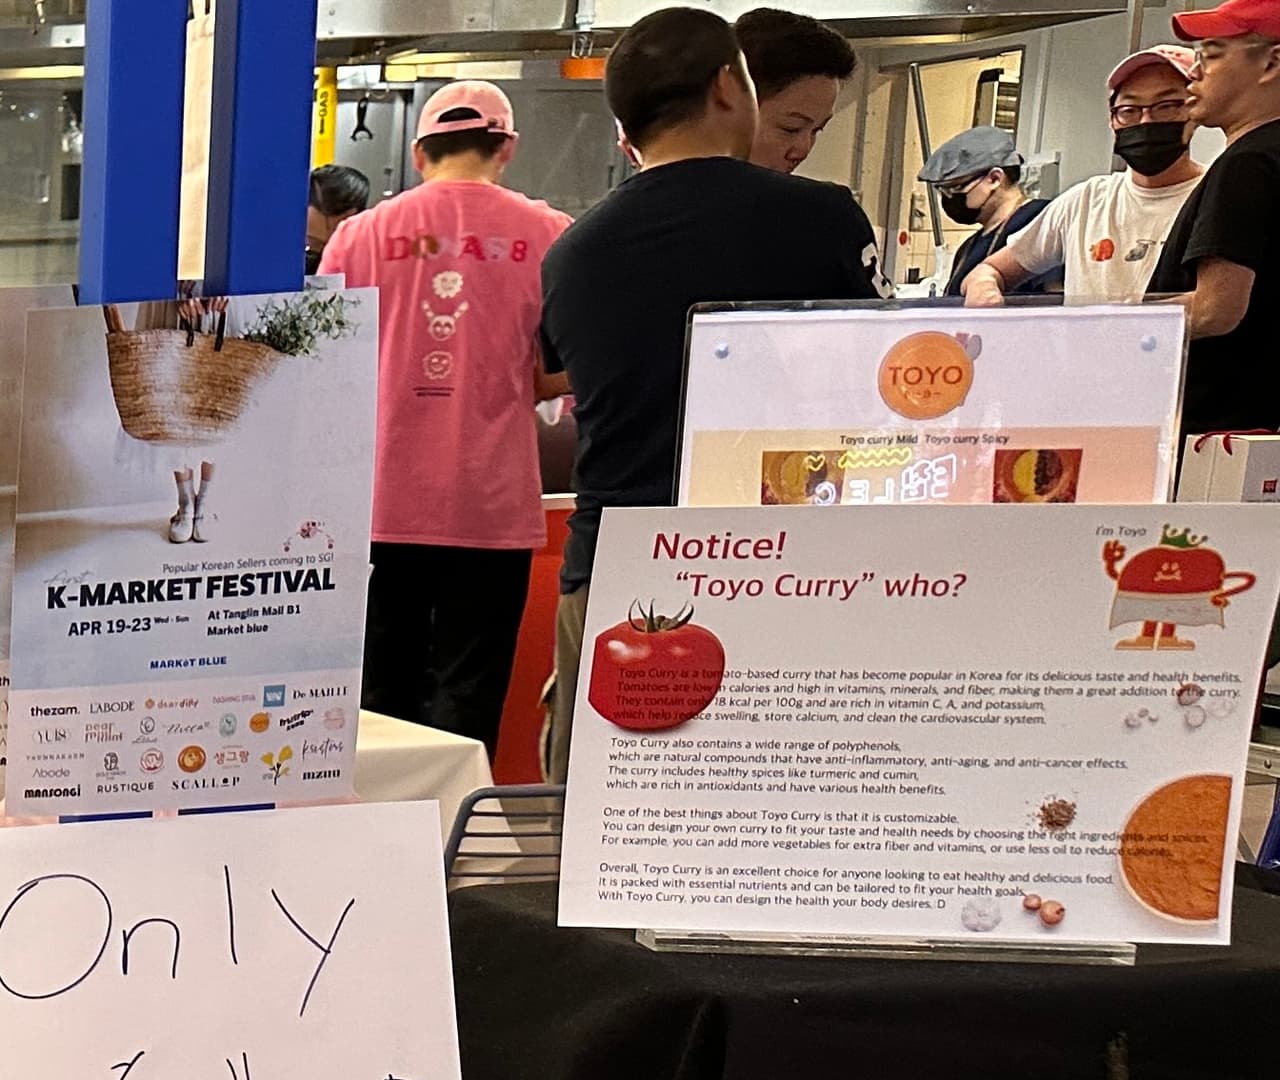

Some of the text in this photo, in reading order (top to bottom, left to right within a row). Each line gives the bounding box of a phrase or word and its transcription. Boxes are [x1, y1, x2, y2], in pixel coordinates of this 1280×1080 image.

[888, 365, 963, 386] TOYO
[840, 434, 1010, 445] Toyo curry Mild Toyo curry Spicy
[1119, 526, 1147, 537] Toyo
[653, 532, 786, 559] Notice!
[163, 563, 199, 574] Popular
[202, 562, 234, 571] Korean
[237, 558, 266, 569] Sellers
[269, 557, 303, 566] coming
[306, 556, 315, 564] to
[47, 568, 335, 609] K-MARKET FESTIVAL
[885, 573, 966, 597] who?
[208, 605, 301, 621] At Tanglin Mall B1
[68, 620, 101, 636] APR
[107, 617, 151, 633] 19-23
[207, 623, 268, 636] Market blue
[199, 656, 227, 666] BLUE
[97, 782, 154, 793] RUSTIQUE
[604, 807, 625, 816] One
[629, 808, 640, 816] of
[643, 808, 660, 817] the
[664, 808, 686, 818] best
[691, 808, 722, 820] things
[726, 809, 757, 819] about
[762, 810, 788, 821] Toyo
[791, 811, 820, 822] Curry
[836, 811, 857, 821] that
[599, 891, 622, 900] With
[627, 891, 652, 902] Toyo
[691, 895, 710, 904] you
[736, 894, 771, 905] design
[775, 895, 792, 905] the
[796, 896, 829, 906] health
[833, 899, 857, 908] your
[861, 897, 888, 909] body
